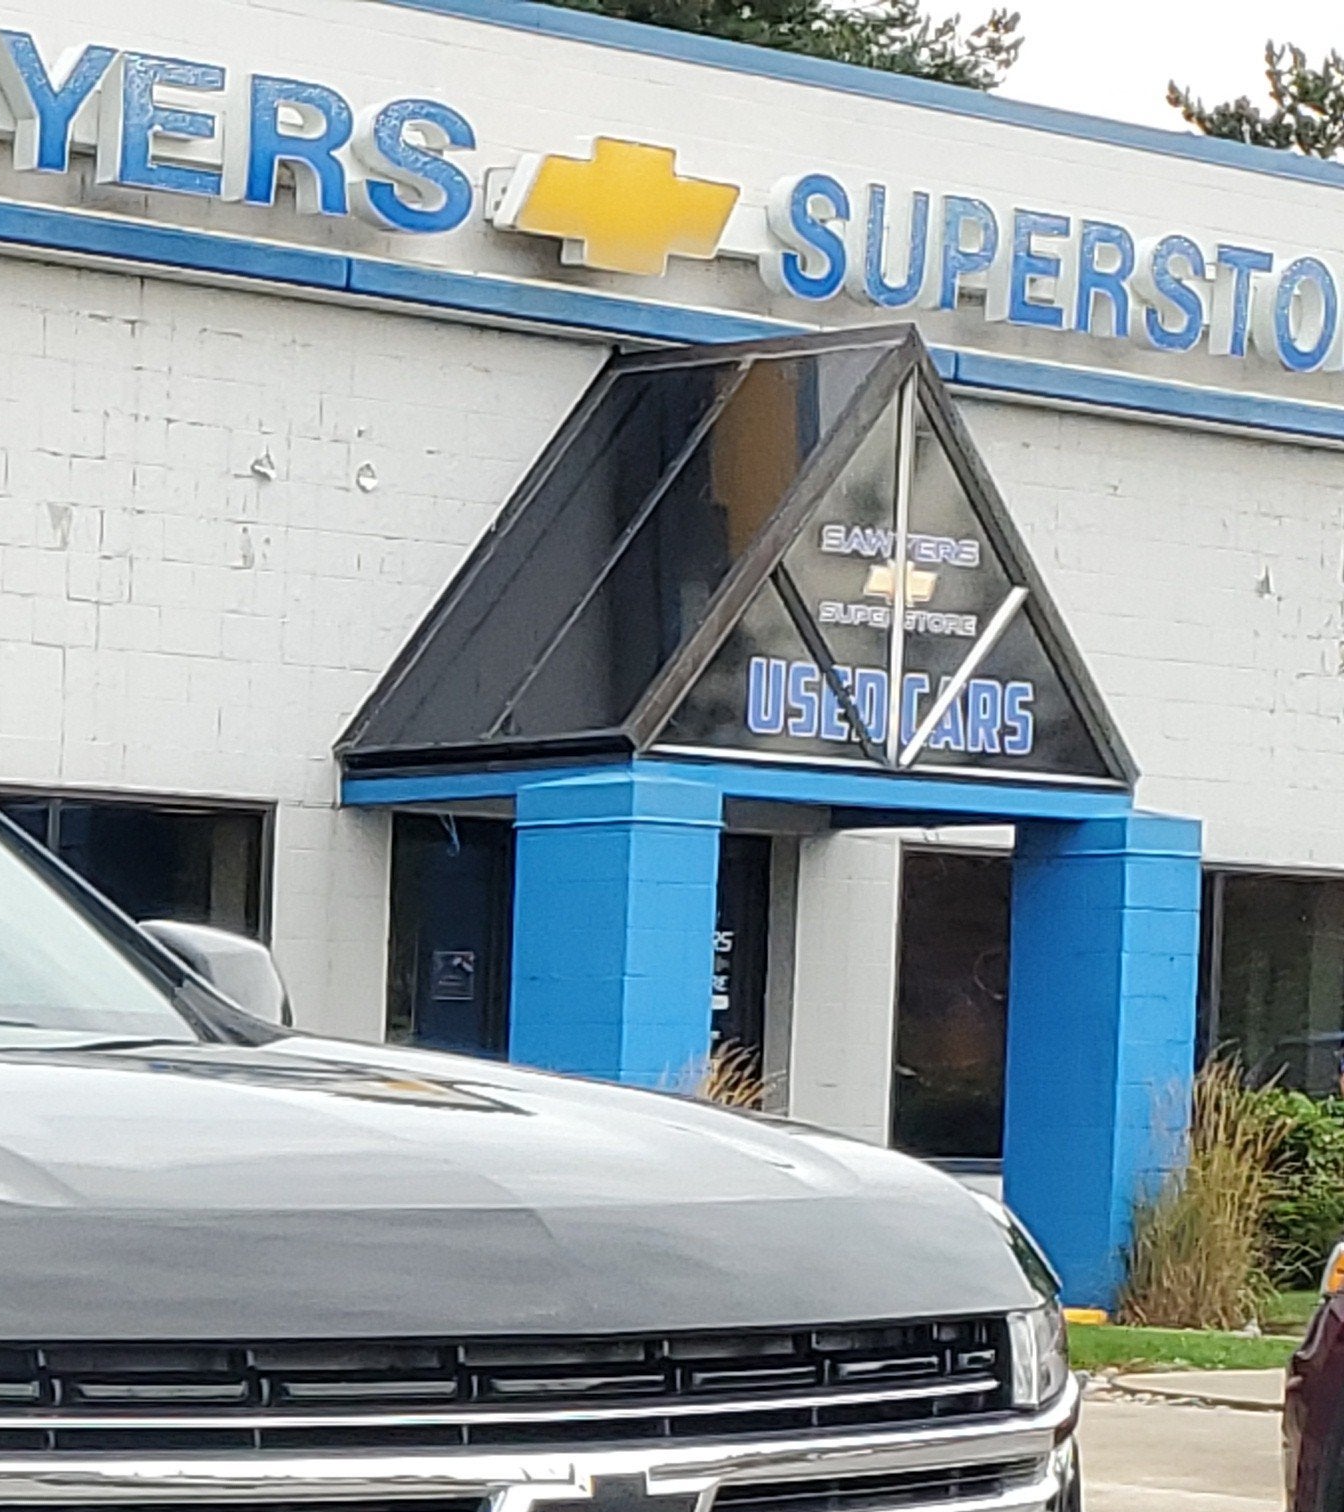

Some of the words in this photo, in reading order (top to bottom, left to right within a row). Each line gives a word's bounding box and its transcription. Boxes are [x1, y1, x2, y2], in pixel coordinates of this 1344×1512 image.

[821, 525, 980, 567] SAWERS
[747, 656, 889, 743] USED
[900, 673, 1035, 756] CARS
